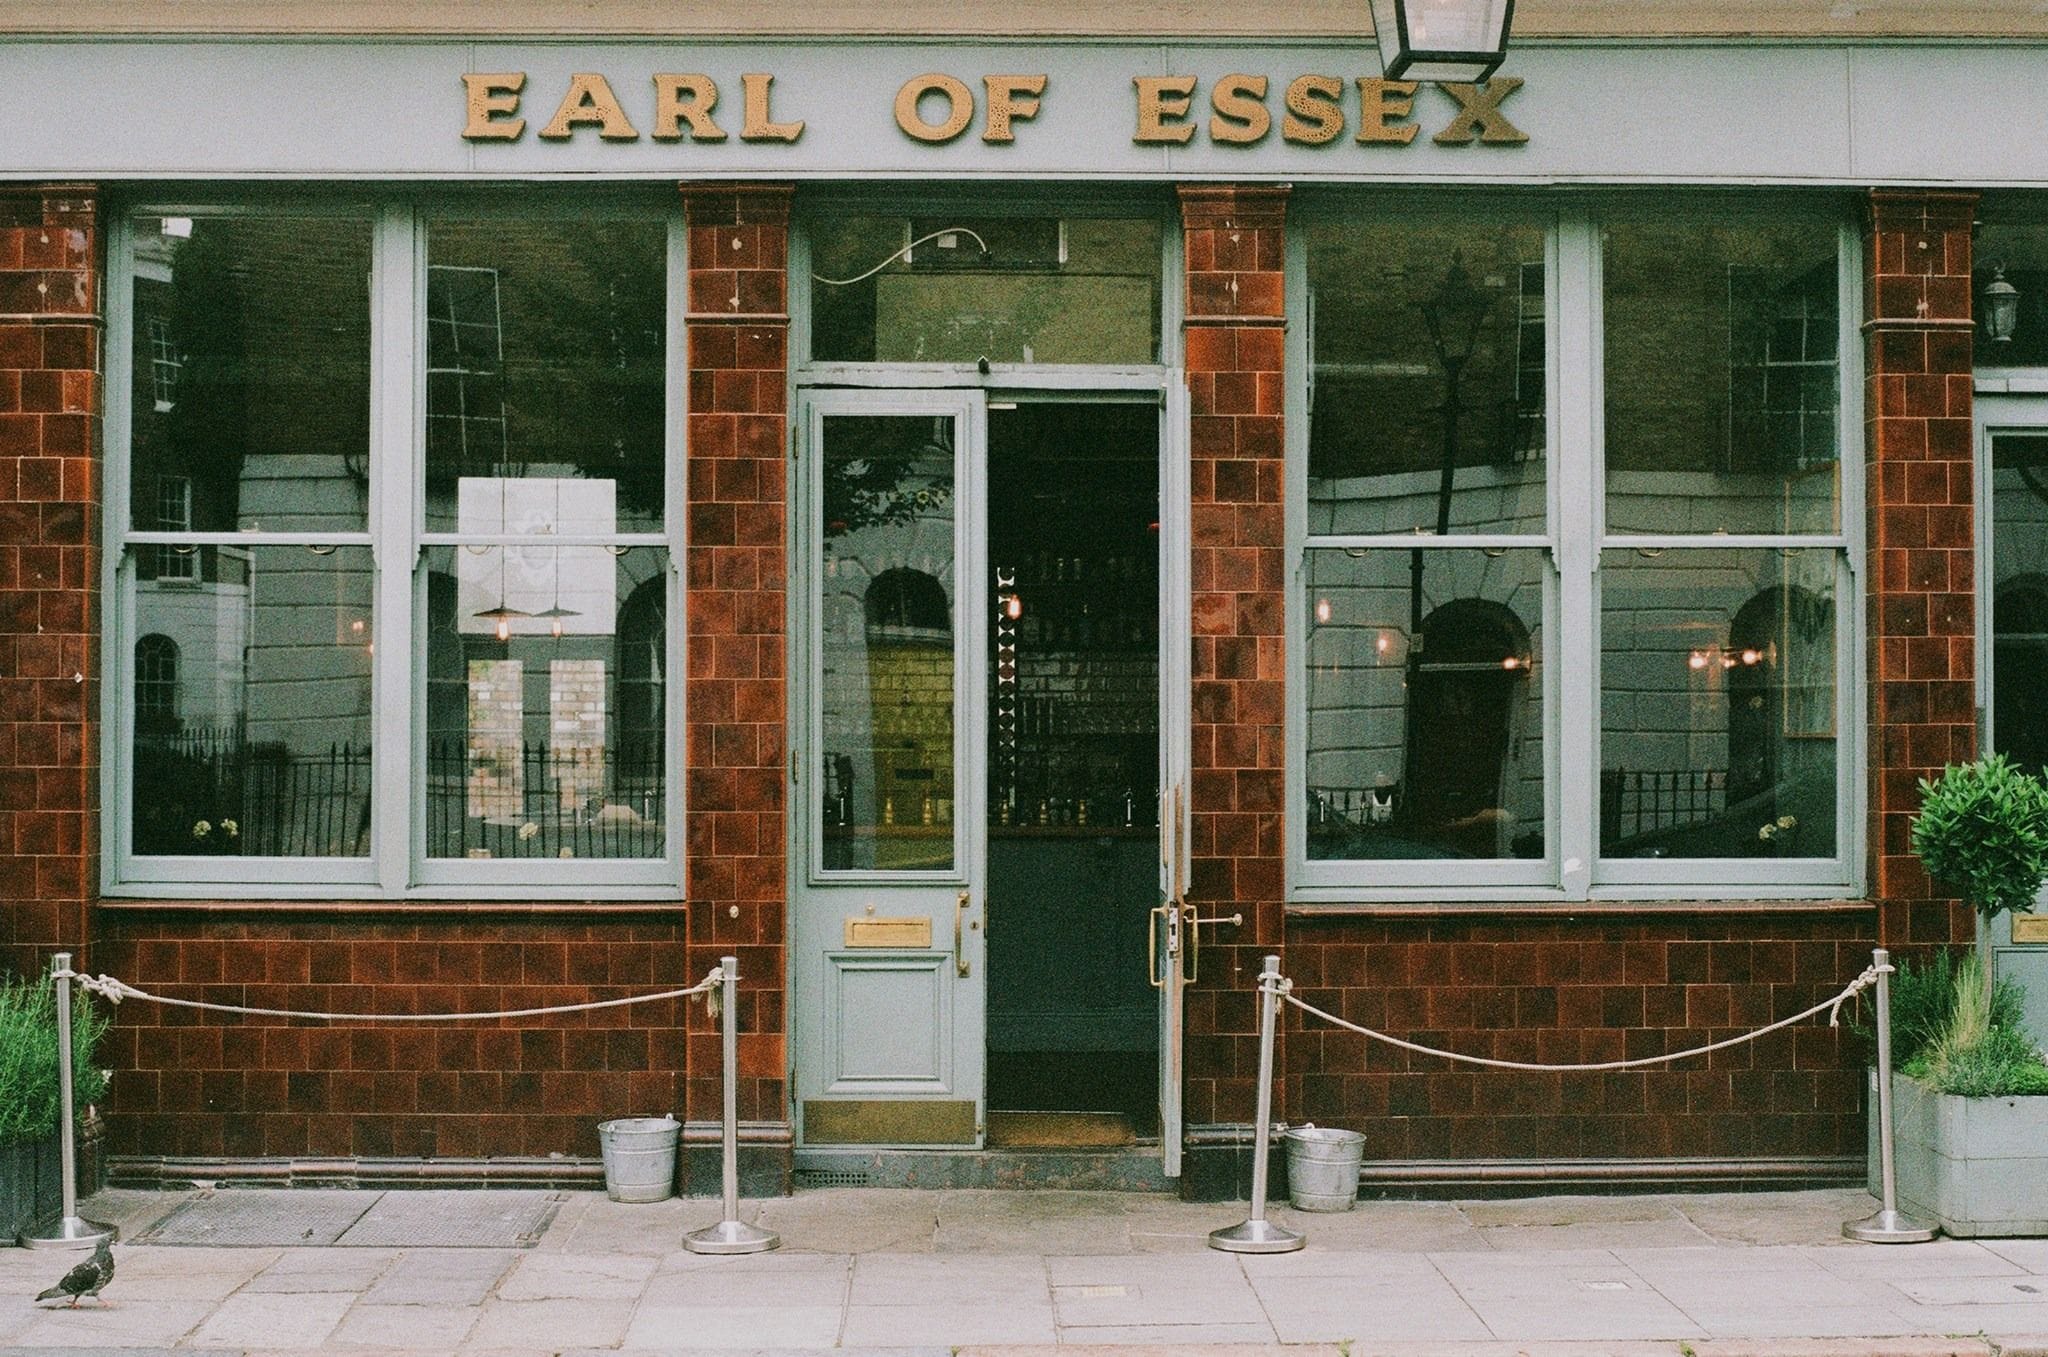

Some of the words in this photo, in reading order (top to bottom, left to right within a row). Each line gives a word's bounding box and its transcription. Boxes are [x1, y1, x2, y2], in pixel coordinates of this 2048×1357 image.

[461, 72, 806, 143] EARL
[894, 72, 1047, 144] OF
[1132, 73, 1530, 144] ESSEX
